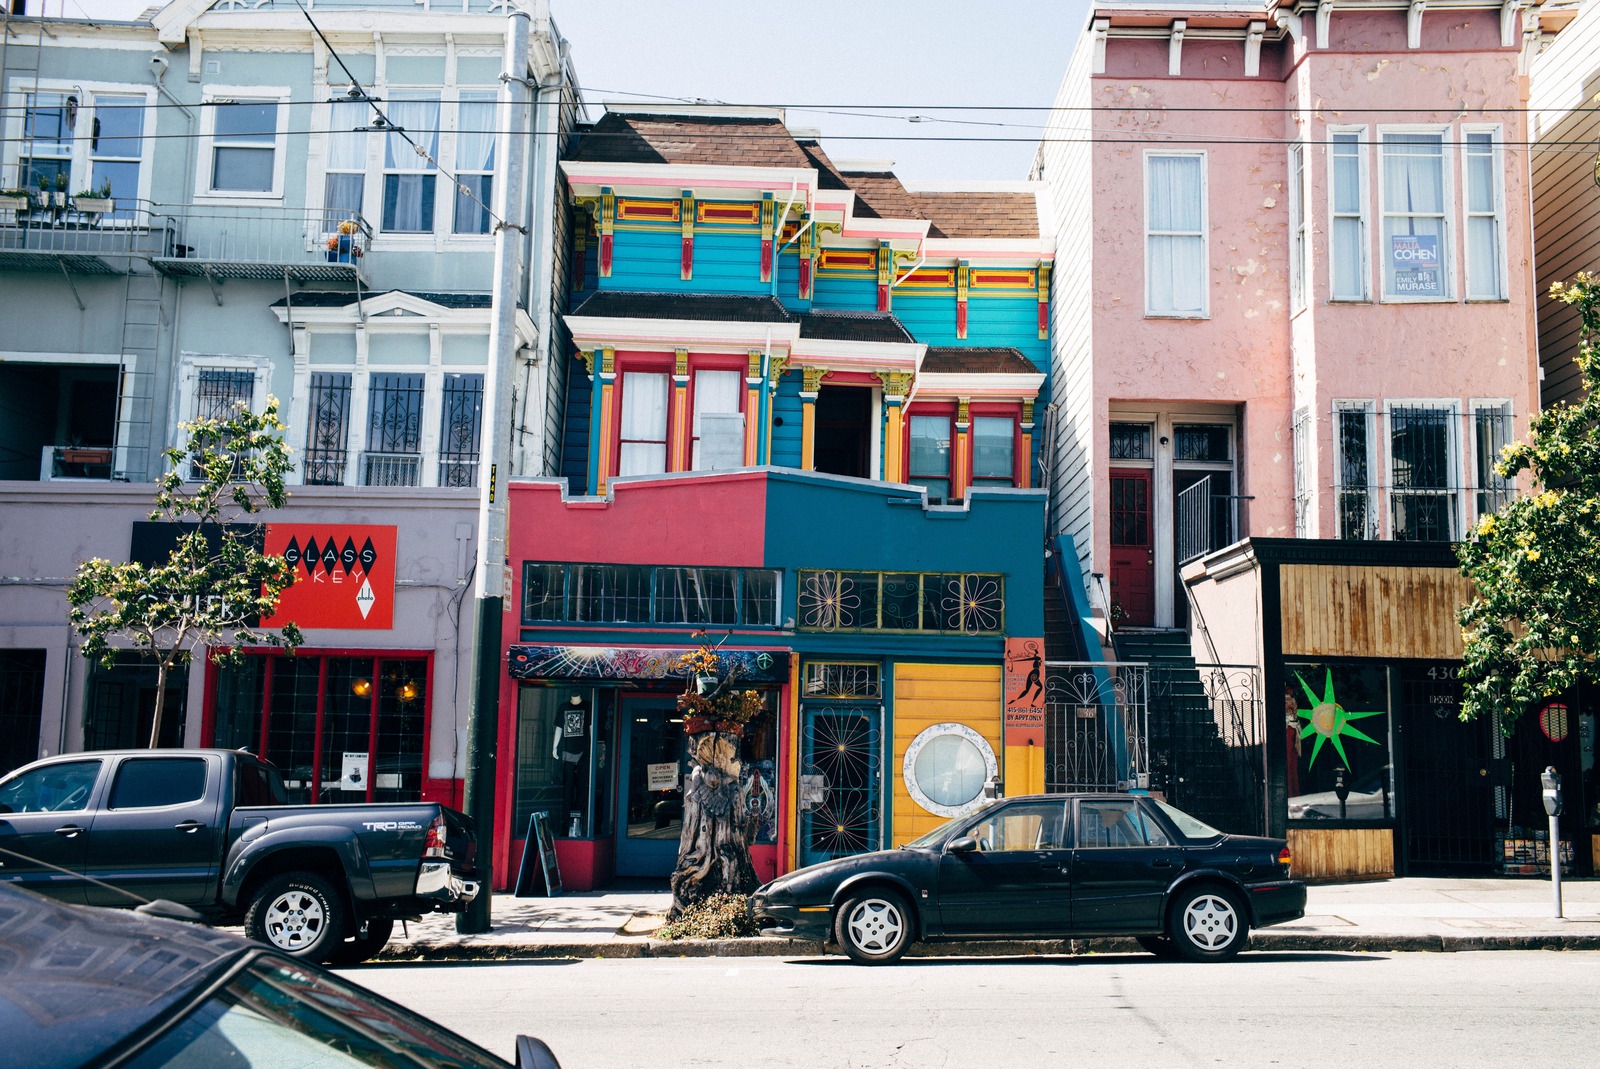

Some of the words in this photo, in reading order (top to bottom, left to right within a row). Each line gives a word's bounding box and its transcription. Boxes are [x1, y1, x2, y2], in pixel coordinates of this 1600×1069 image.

[1394, 245, 1437, 260] COHEN
[1396, 282, 1437, 290] MURASE
[285, 549, 374, 562] GLASS
[313, 570, 363, 583] KEY
[357, 588, 374, 601] photo
[362, 822, 398, 831] TRD
